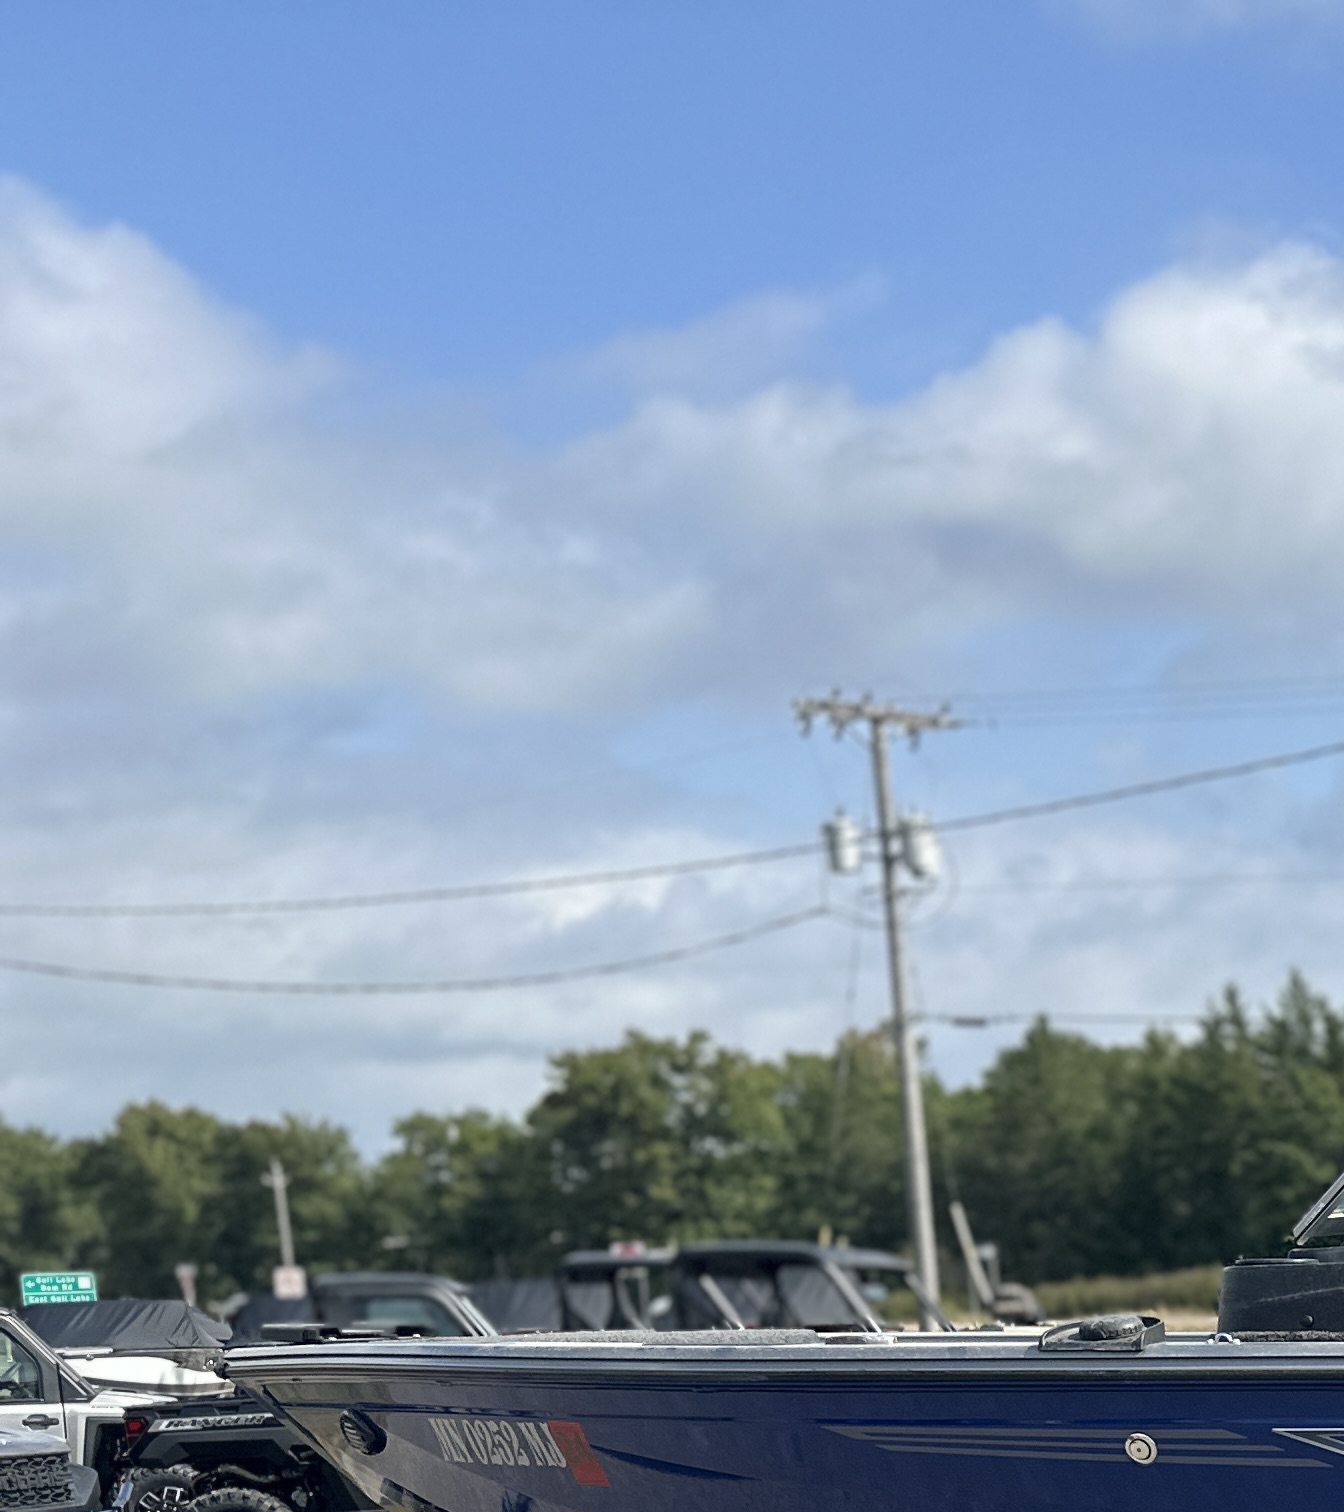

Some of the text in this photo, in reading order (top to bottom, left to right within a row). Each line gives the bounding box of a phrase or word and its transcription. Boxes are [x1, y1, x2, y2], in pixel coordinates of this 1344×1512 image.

[428, 1417, 567, 1468] MN 0252 MJ
[0, 1471, 72, 1491] OLARIS
